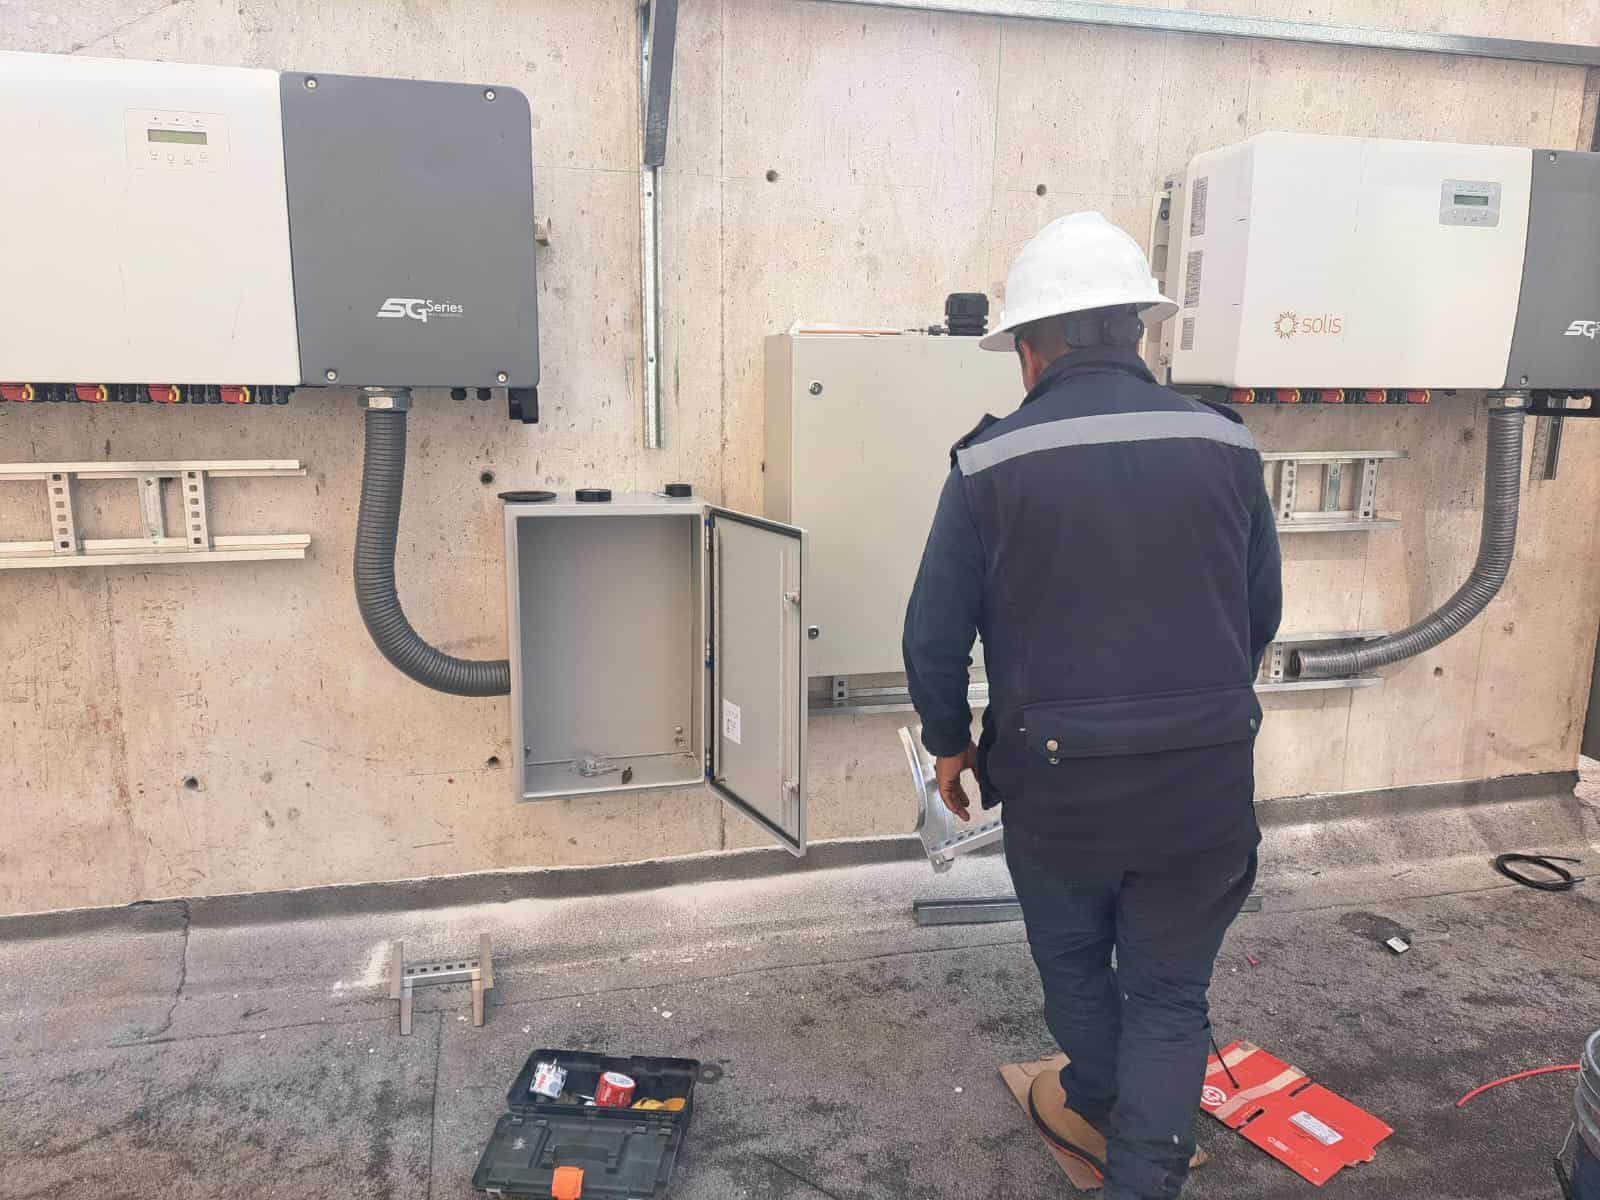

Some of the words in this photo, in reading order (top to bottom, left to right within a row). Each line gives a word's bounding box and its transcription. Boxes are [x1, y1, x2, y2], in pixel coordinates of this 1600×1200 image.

[376, 298, 427, 323] SG
[426, 299, 464, 313] Series
[1302, 313, 1342, 334] solis
[1563, 320, 1595, 340] SG
